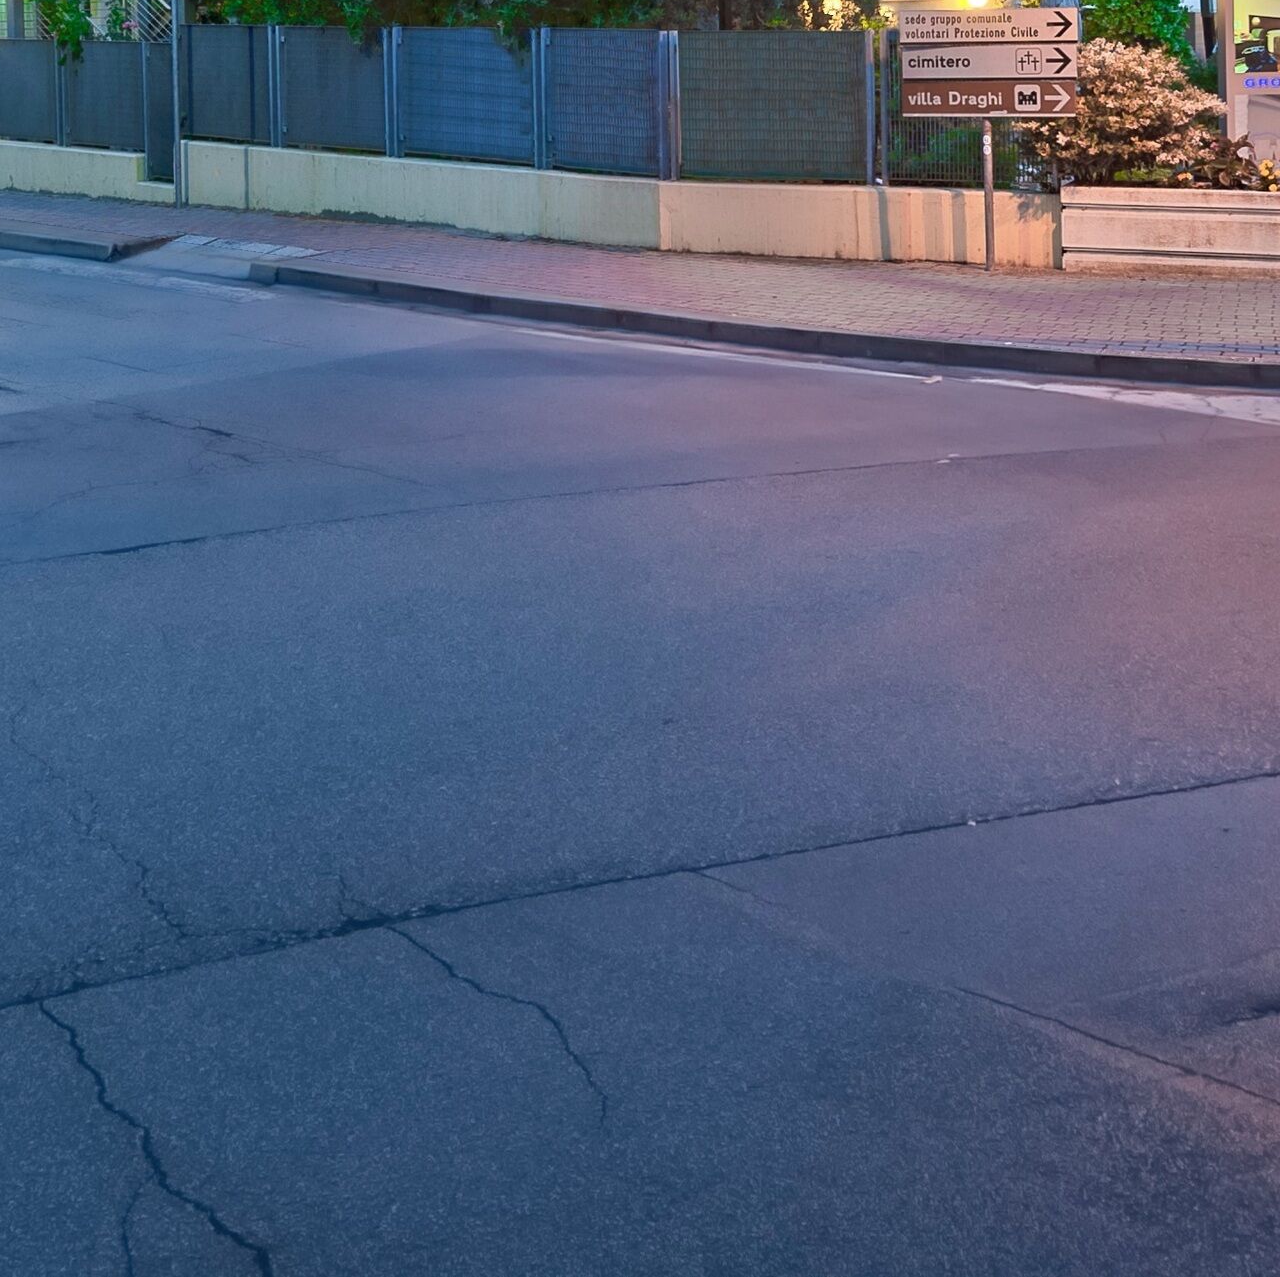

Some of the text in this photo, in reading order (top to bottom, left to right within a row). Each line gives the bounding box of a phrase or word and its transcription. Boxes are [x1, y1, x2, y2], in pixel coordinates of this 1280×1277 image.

[905, 12, 1012, 26] sede gruppo comunale
[905, 25, 1039, 39] volontari Protezione Civile
[908, 55, 971, 68] cimitero
[908, 91, 1002, 108] villa Draghi
